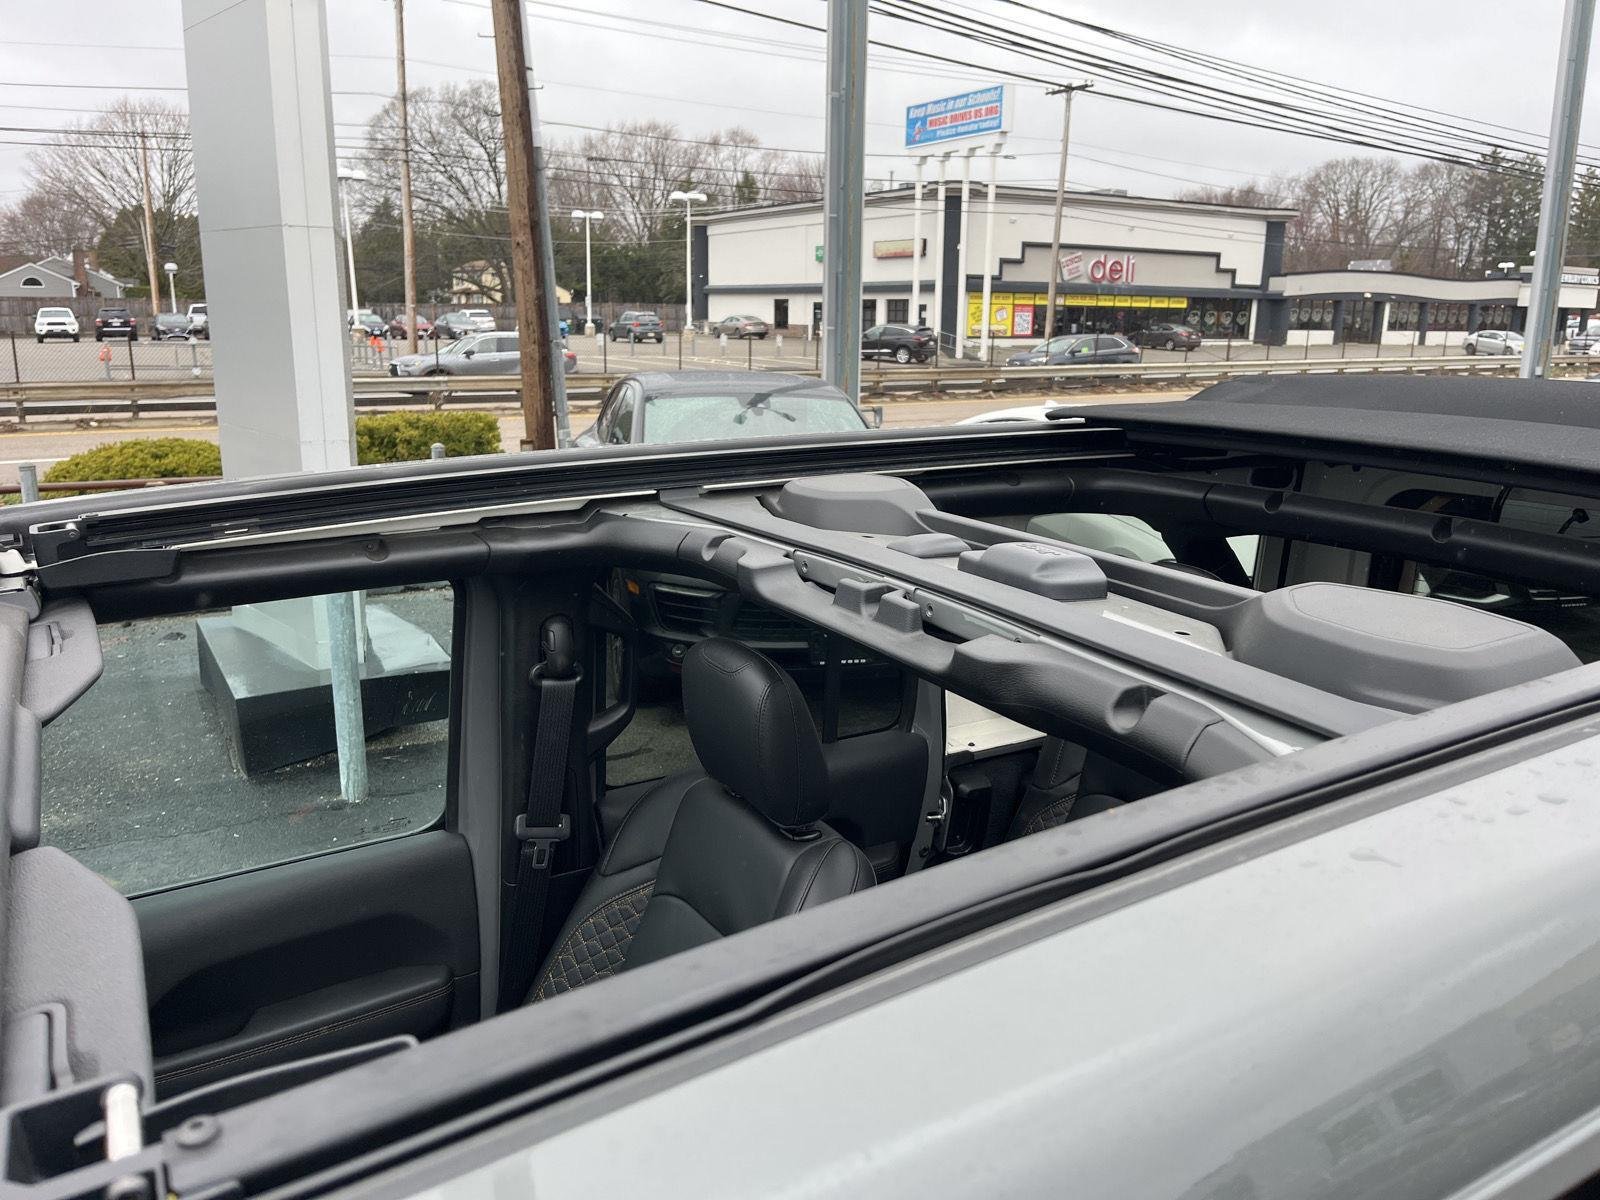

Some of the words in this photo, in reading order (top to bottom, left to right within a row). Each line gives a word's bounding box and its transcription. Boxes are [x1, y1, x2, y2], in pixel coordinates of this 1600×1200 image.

[928, 116, 947, 128] MUSIC
[949, 109, 972, 124] DRIVES
[1089, 254, 1135, 283] deli
